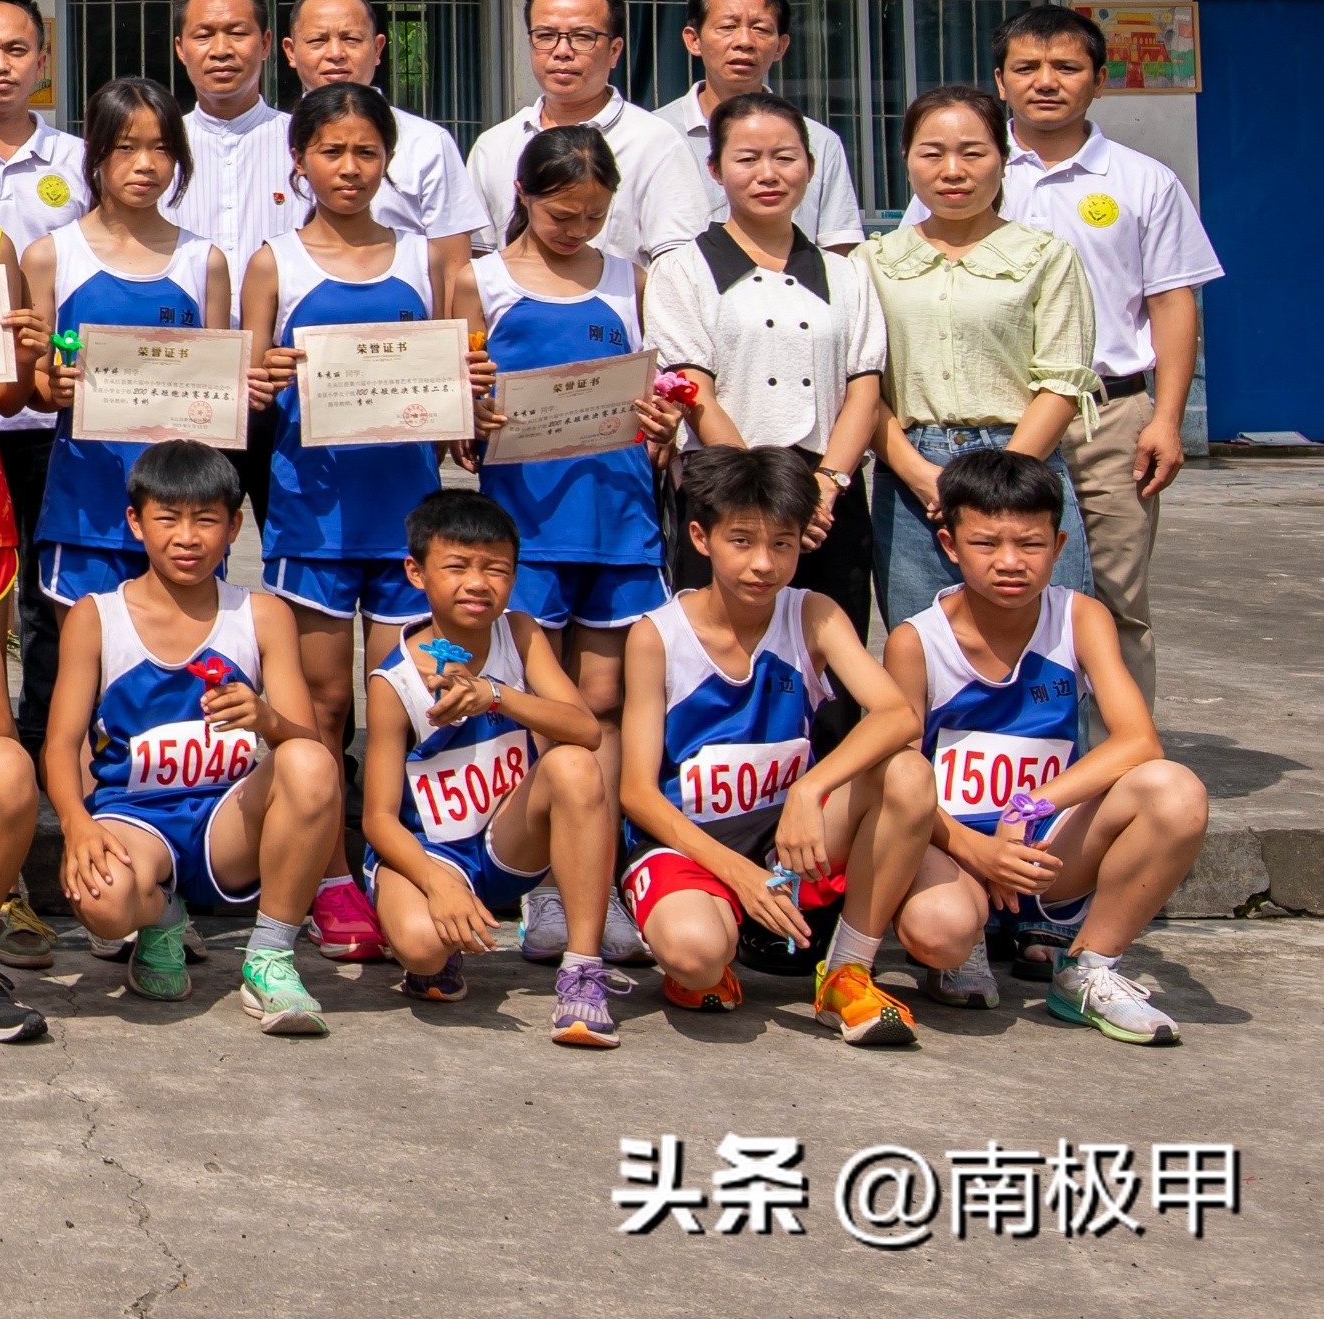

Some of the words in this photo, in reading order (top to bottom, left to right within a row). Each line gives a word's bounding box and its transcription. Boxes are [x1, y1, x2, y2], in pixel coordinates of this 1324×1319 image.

[161, 307, 195, 327] 刚边
[588, 324, 623, 346] 刚边
[138, 346, 189, 358] 荣誉证书
[357, 342, 407, 354] 荣誉证书
[553, 377, 600, 393] 荣誉证书
[1029, 680, 1073, 705] 刚边
[136, 738, 251, 788] 15046
[416, 746, 525, 827] 15048
[686, 755, 802, 814] 15044
